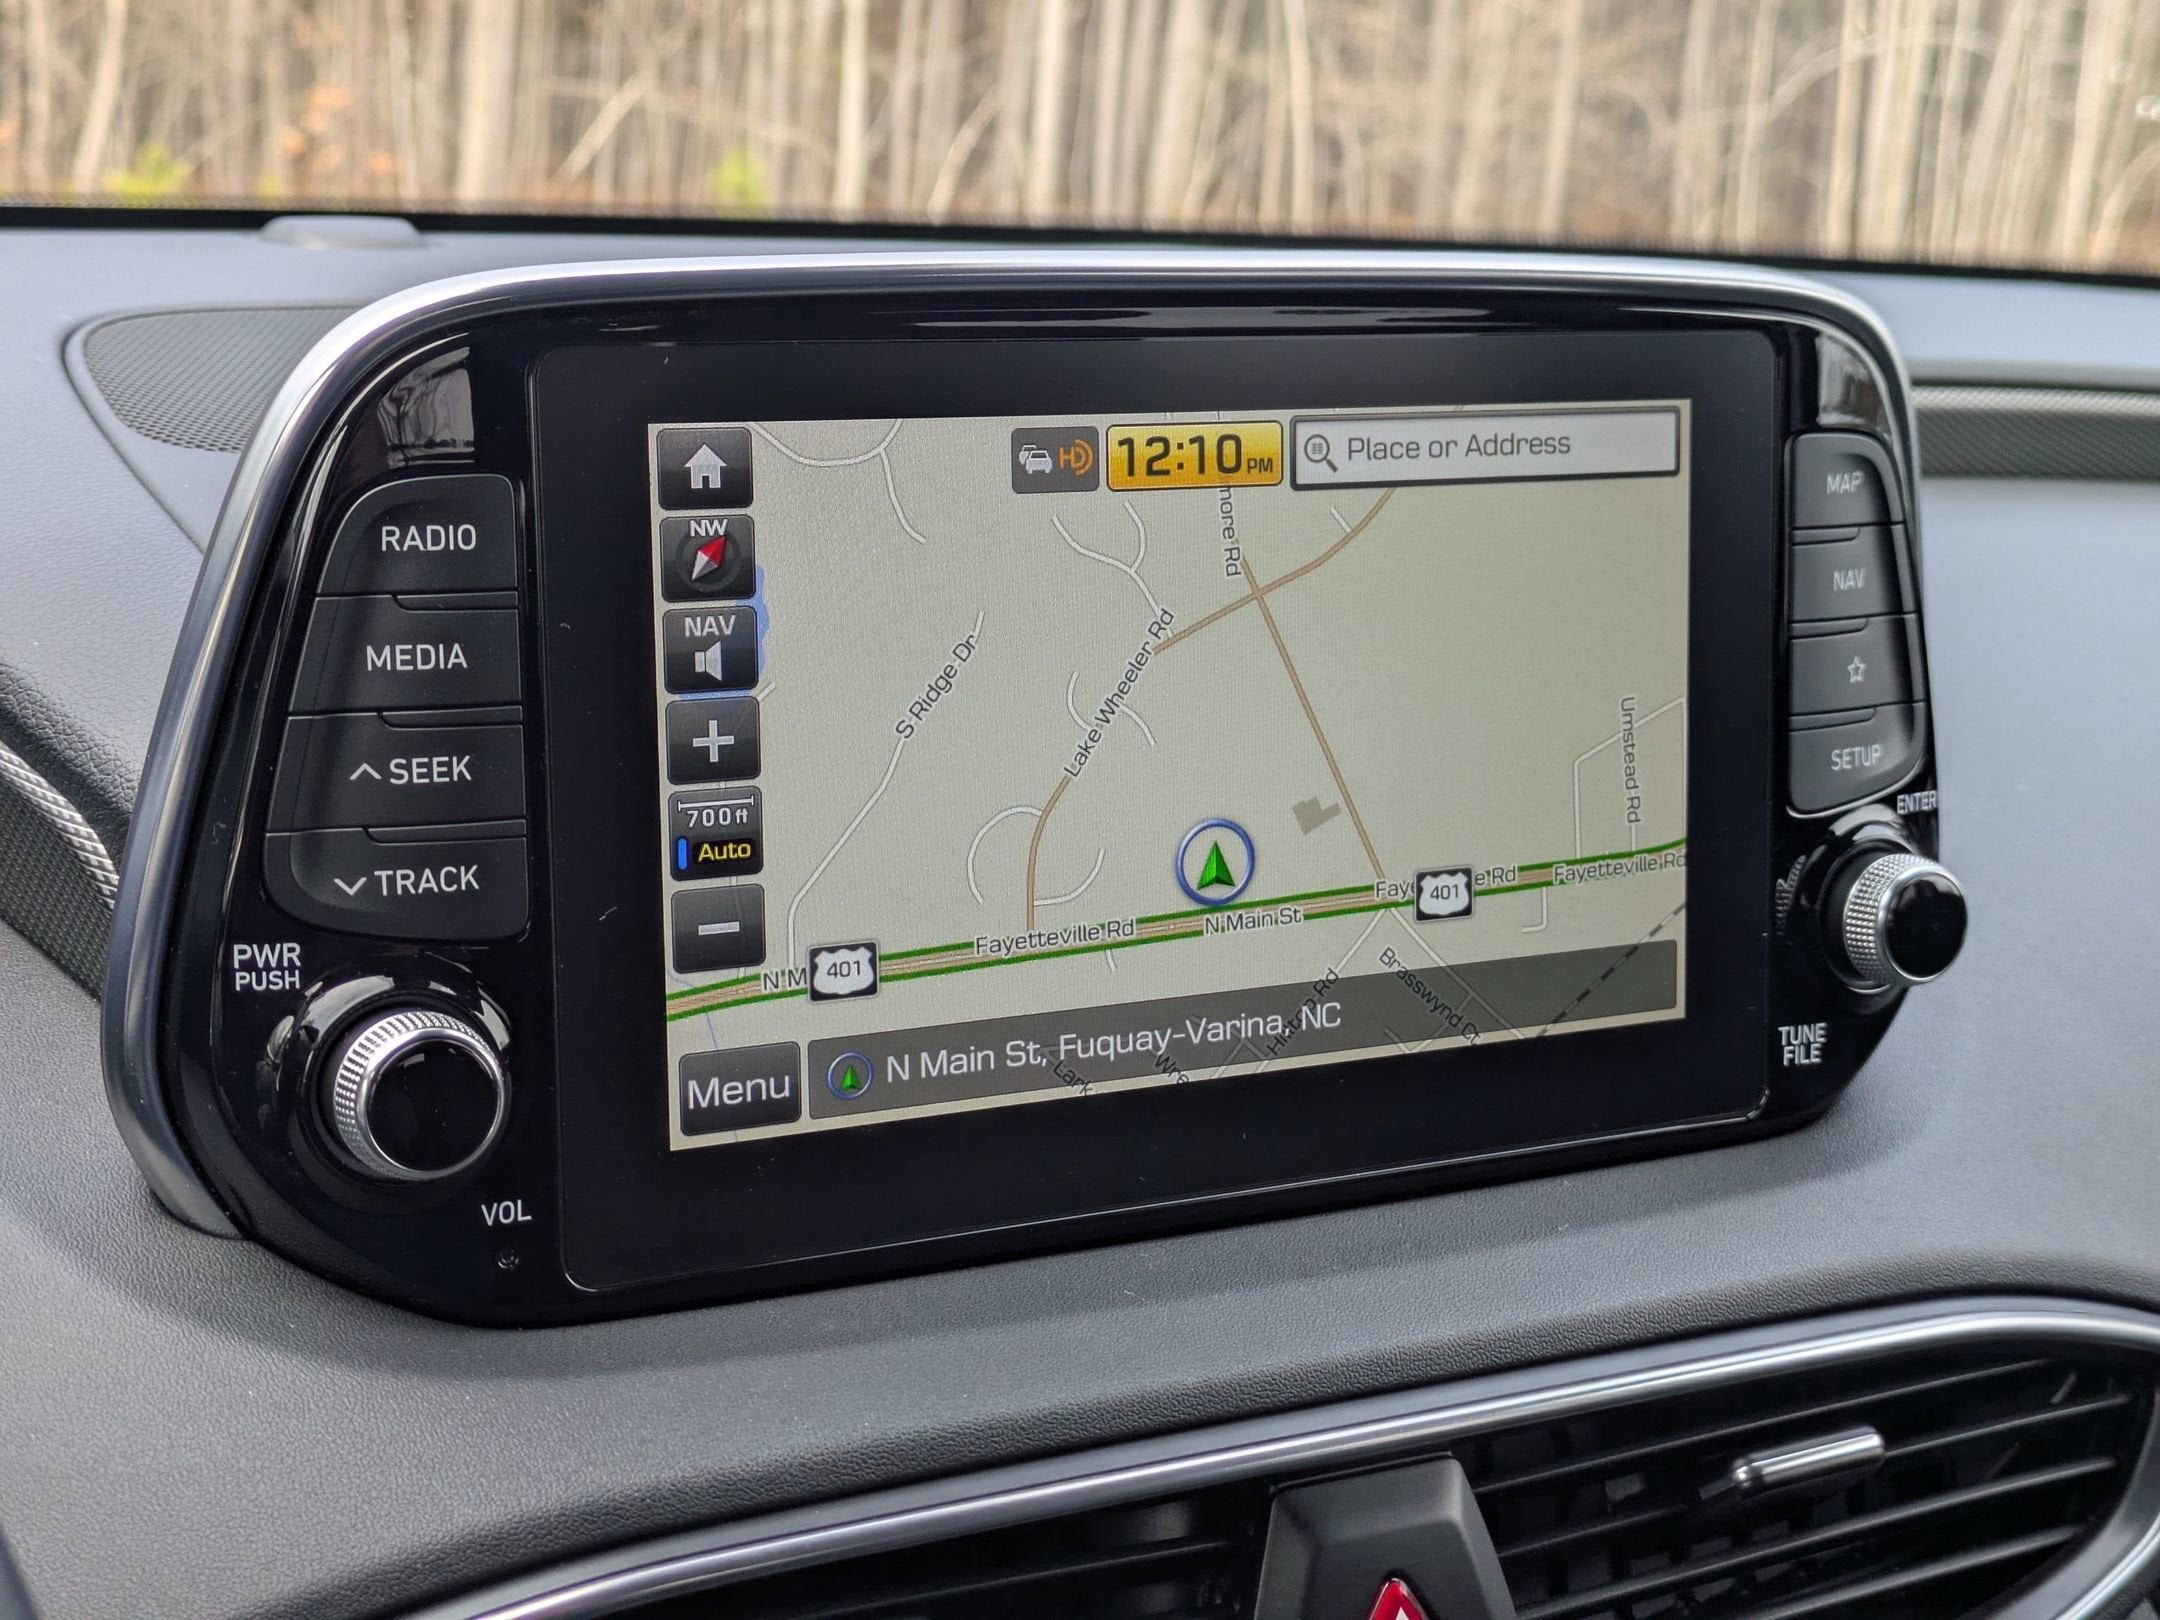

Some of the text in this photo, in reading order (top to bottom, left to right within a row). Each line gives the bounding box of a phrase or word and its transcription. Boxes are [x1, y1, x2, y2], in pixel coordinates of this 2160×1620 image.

[1117, 433, 1274, 477] 12:10 PM
[1347, 432, 1571, 461] Place or Address
[1826, 471, 1863, 495] MAP
[381, 524, 477, 552] RADIO
[689, 518, 728, 537] NW
[1224, 546, 1242, 577] Rd
[1833, 569, 1865, 591] NAV
[684, 614, 737, 638] NAV
[366, 643, 468, 671] MEDIA
[895, 634, 976, 740] S Ridge Dr
[1063, 608, 1175, 778] Lake Wheeler Rd
[389, 755, 473, 785] SEEK
[1620, 696, 1642, 824] Umstead Rd
[1830, 745, 1882, 771] SETUP
[1897, 790, 1937, 814] ENTER
[698, 842, 752, 863] Auto
[373, 865, 480, 896] TRACK
[1492, 865, 1516, 884] Rd
[1554, 856, 1658, 884] Fayetteville
[1430, 885, 1459, 900] 401
[1205, 907, 1300, 935] N Main St
[975, 919, 1134, 957] Fayetteville Rd
[232, 943, 301, 969] PWR
[826, 960, 861, 978] 401
[234, 970, 301, 992] PUSH
[763, 971, 779, 991] N
[1313, 967, 1339, 997] Rd
[1378, 947, 1481, 1046] Brasswynd Ct
[886, 1001, 1341, 1083] N Main St, Fuquay-Varina, NC
[1778, 1022, 1827, 1045] TUNE
[1783, 1044, 1822, 1066] FILE
[687, 1075, 791, 1110] Menu
[481, 1199, 532, 1227] VOL
